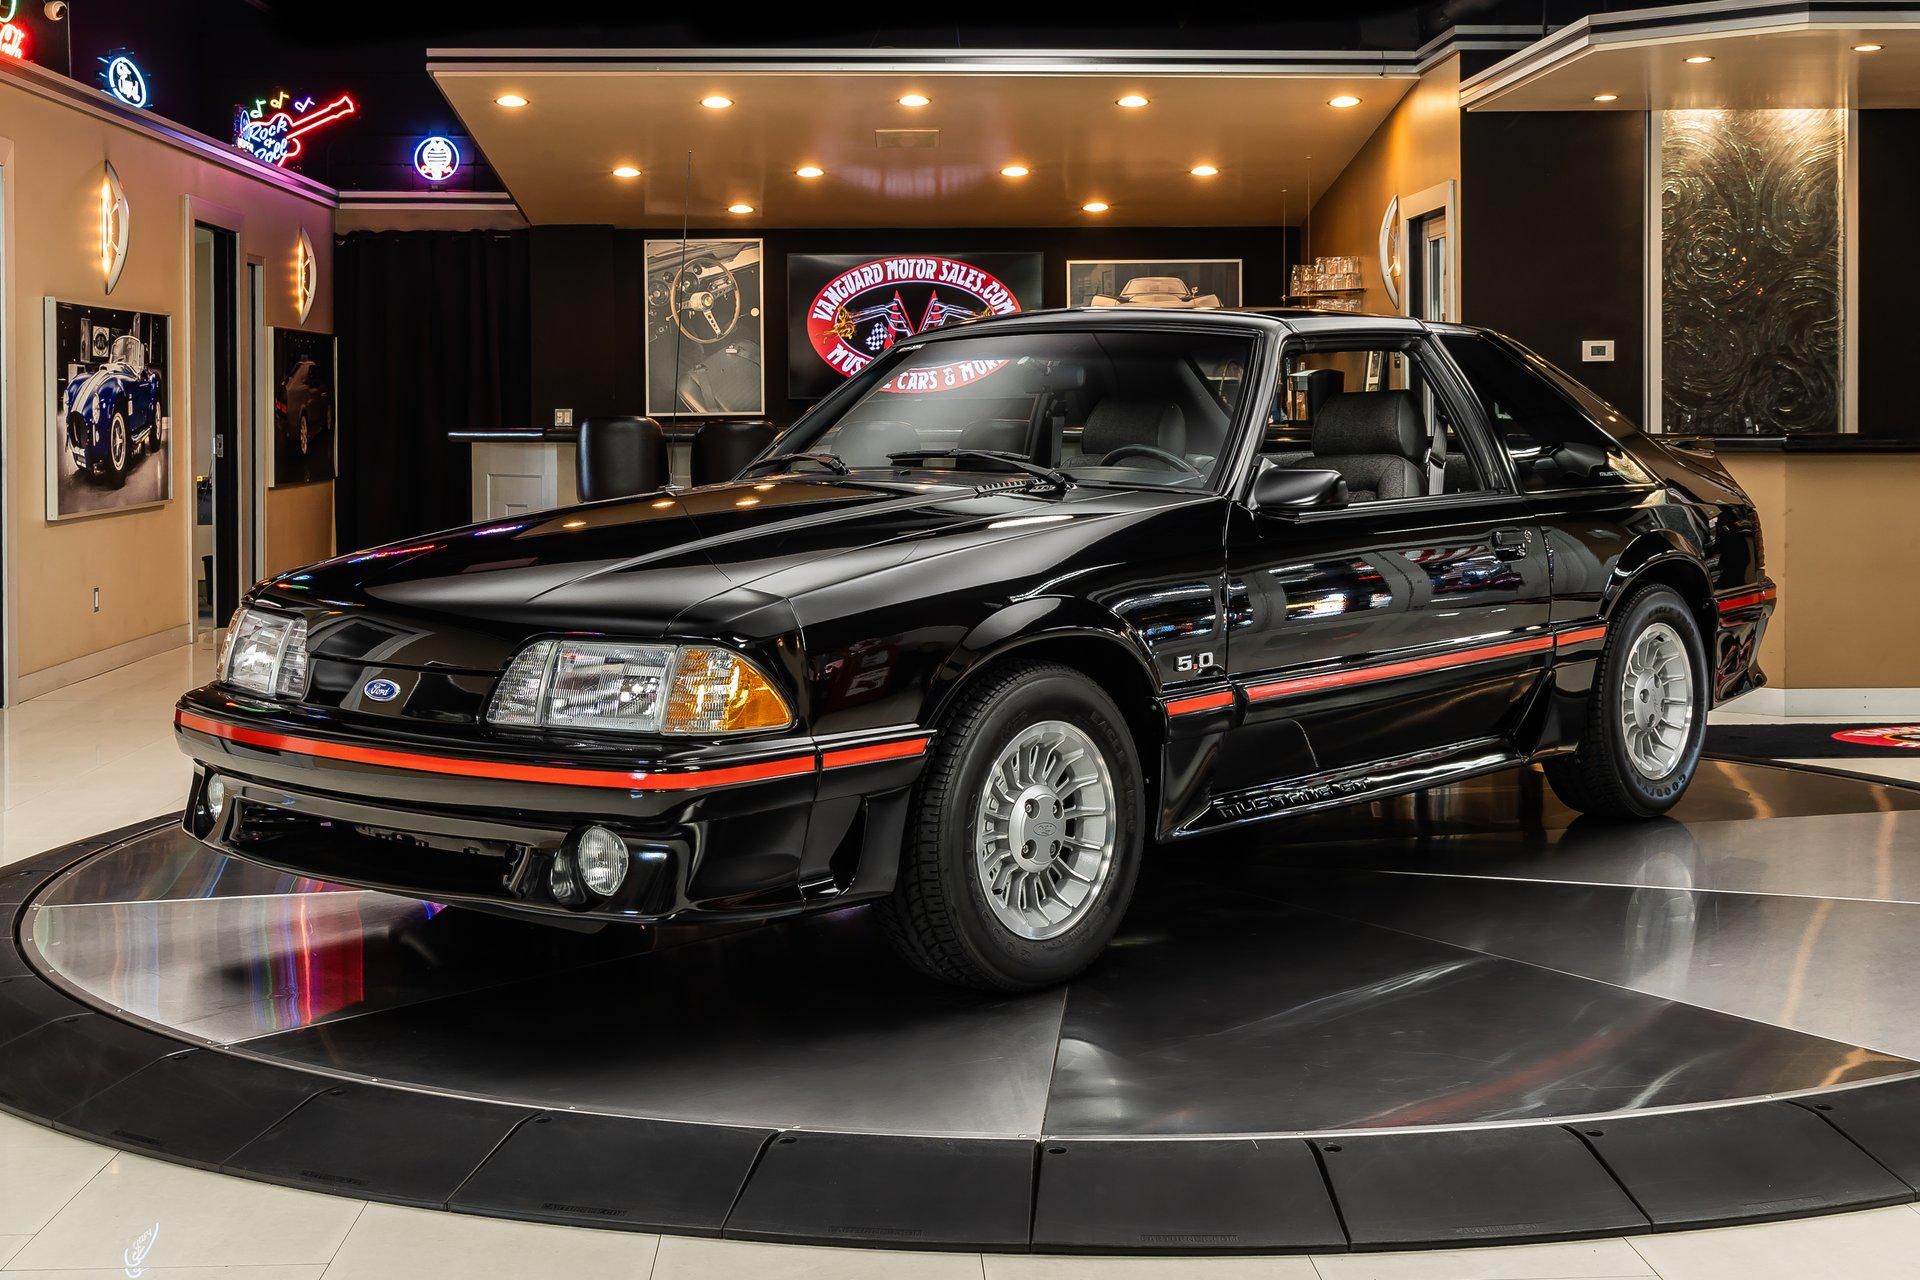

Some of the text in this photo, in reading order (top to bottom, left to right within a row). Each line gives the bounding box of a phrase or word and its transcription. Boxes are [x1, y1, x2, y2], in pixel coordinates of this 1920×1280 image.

[248, 114, 288, 142] Rock
[812, 259, 1016, 321] VANGUARD MOTOR SALES.COM
[897, 371, 937, 390] CARS
[943, 367, 956, 386] &
[1177, 652, 1214, 672] 5.0
[370, 682, 391, 696] Ford
